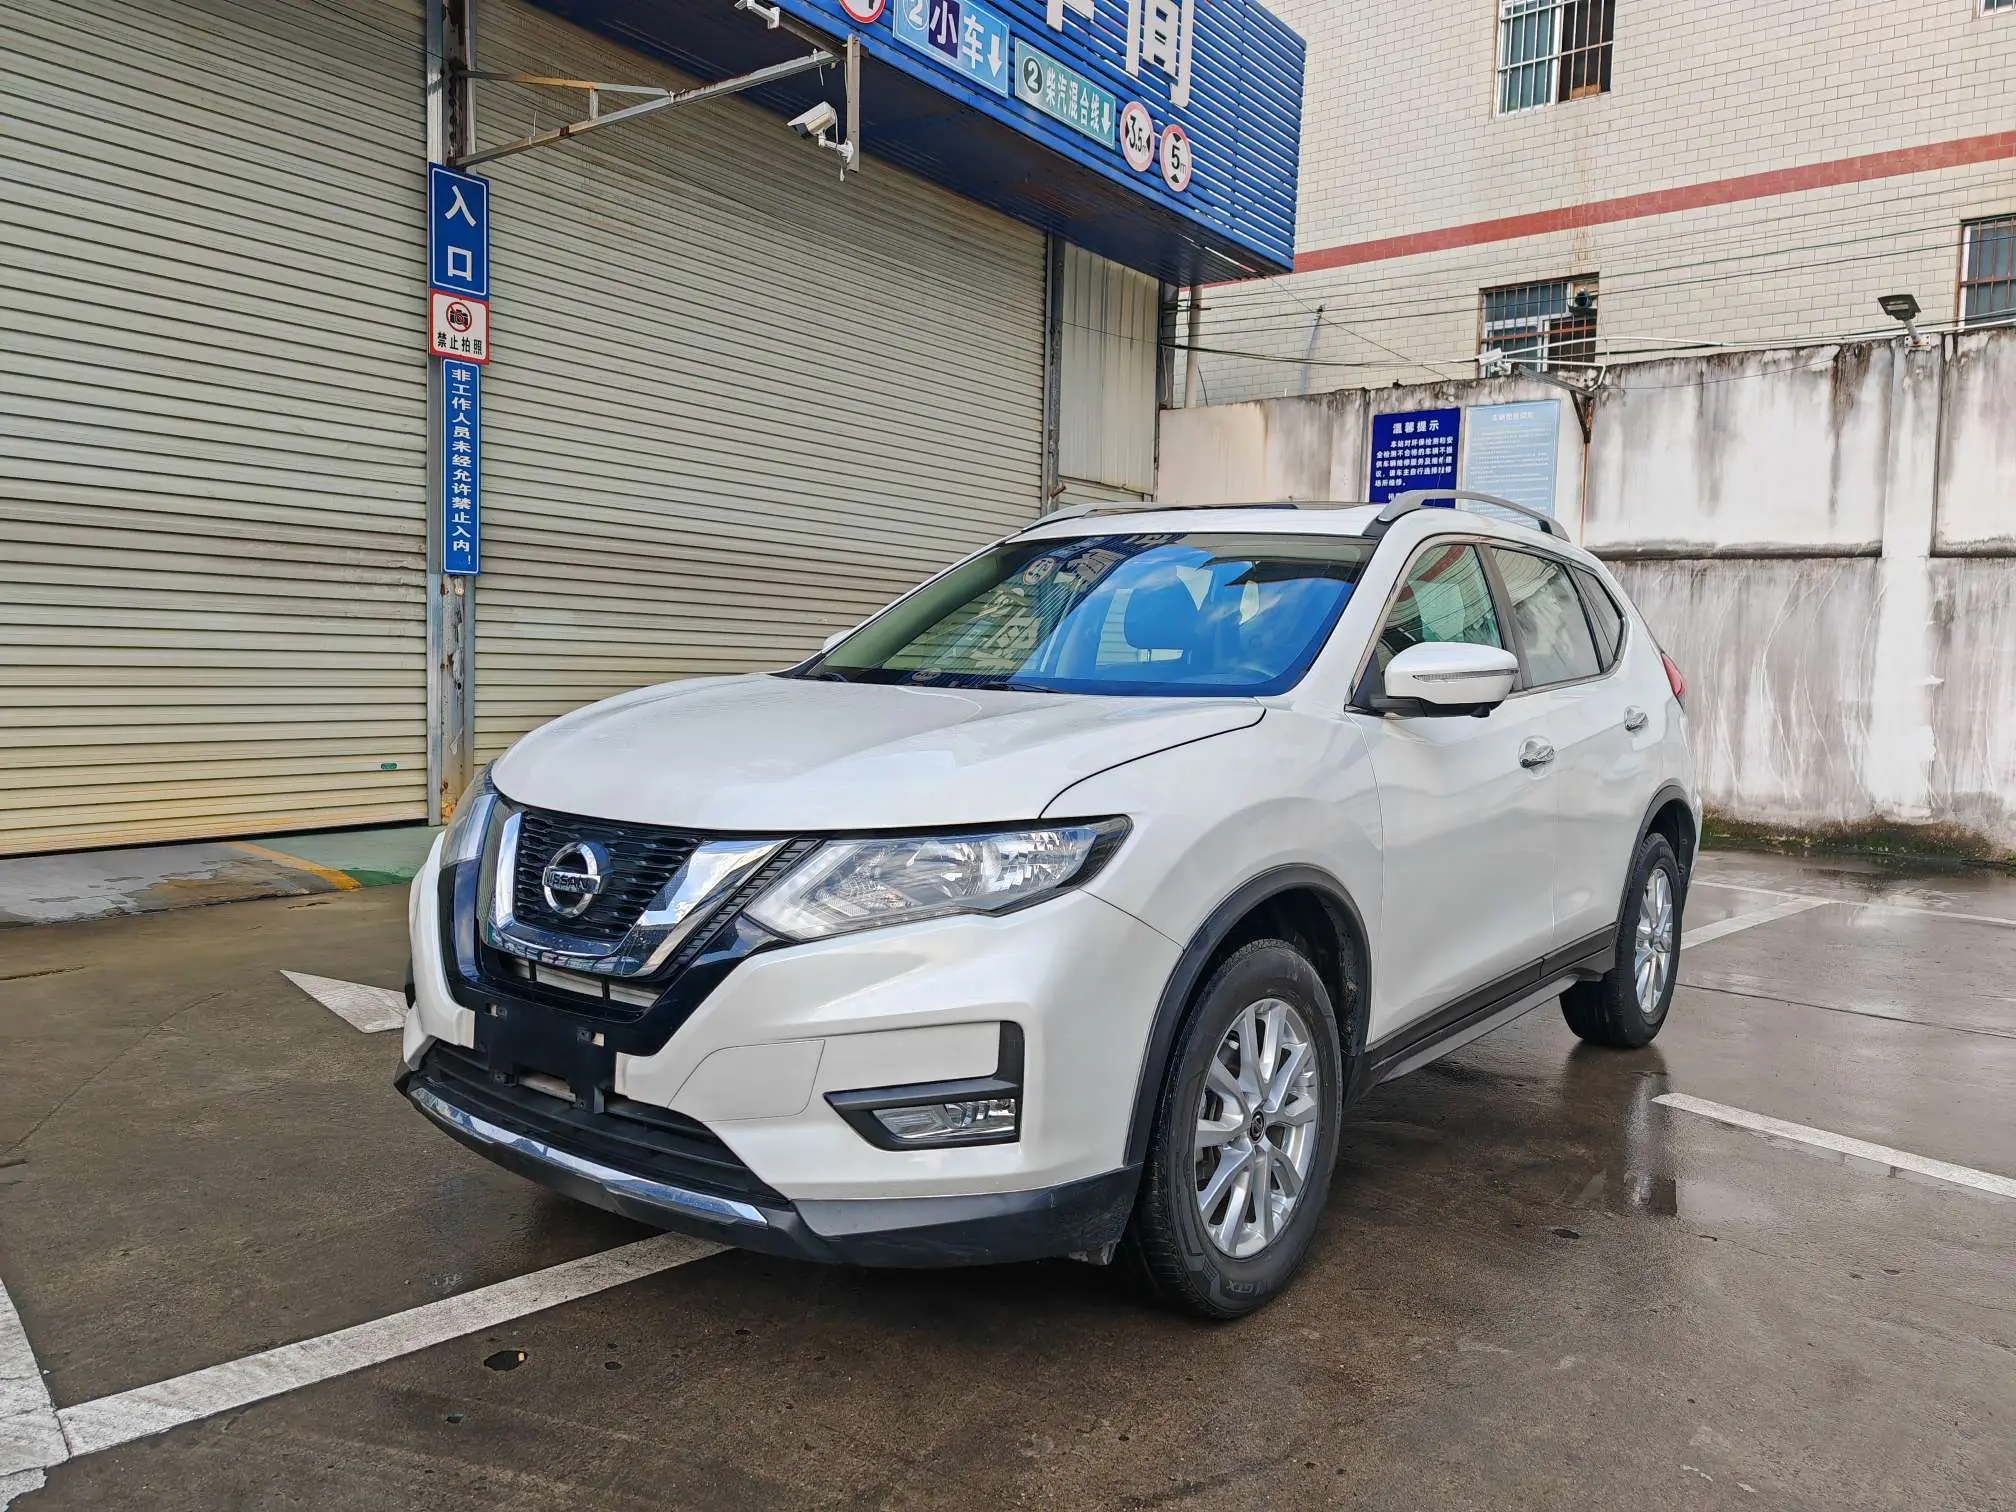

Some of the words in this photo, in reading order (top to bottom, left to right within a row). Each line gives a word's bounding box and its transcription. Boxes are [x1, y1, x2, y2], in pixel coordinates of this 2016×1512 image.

[444, 185, 477, 281] 入口
[437, 332, 482, 355] 禁止拍照
[1392, 420, 1440, 434] 温馨提示
[544, 872, 586, 891] NISSAN
